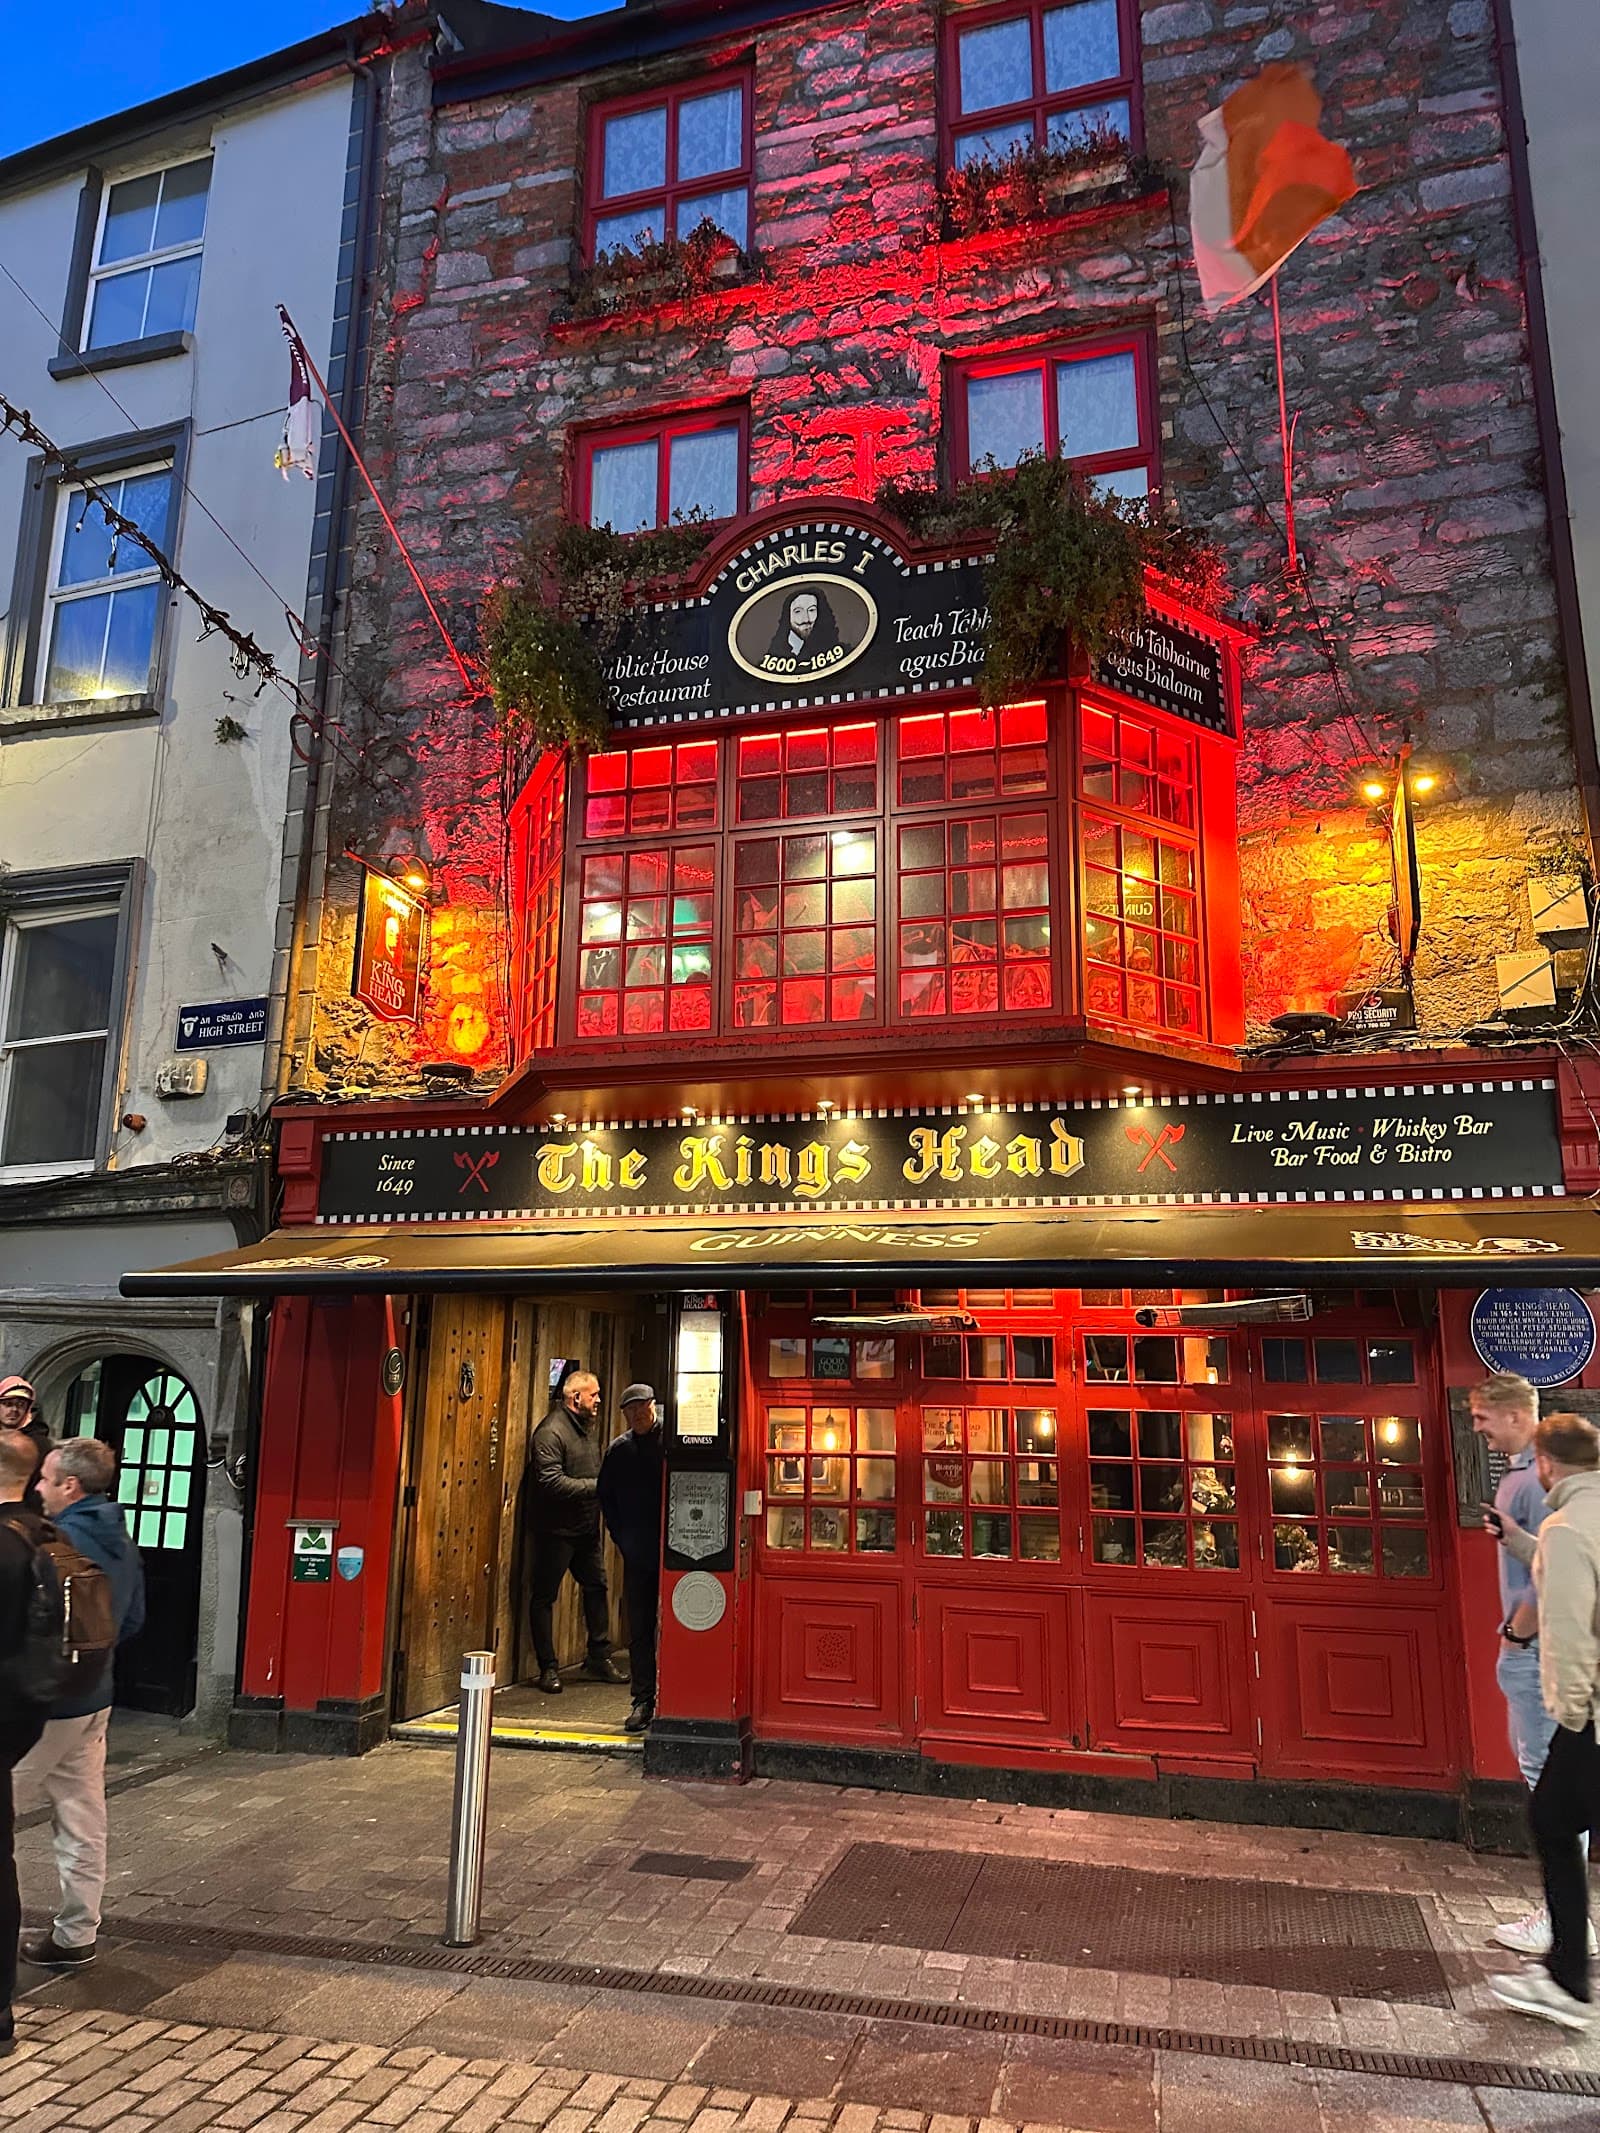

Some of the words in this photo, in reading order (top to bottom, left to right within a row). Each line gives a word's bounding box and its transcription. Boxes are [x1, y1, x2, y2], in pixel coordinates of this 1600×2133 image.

[736, 541, 847, 592] CHARLES
[853, 550, 874, 575] I
[893, 615, 943, 643] Teach
[1145, 628, 1211, 681] Tábhairne
[601, 655, 649, 680] ublic
[1144, 656, 1204, 705] Bialann
[608, 677, 712, 711] Restaurant
[369, 980, 402, 1010] HEAD
[1363, 1008, 1397, 1019] SECURITY
[198, 1025, 224, 1039] HIGH
[227, 1020, 265, 1035] STREET
[1231, 1123, 1274, 1144] Live
[1281, 1120, 1350, 1142] Music
[1372, 1116, 1448, 1144] Whiskey
[1453, 1114, 1494, 1136] Bar
[378, 1154, 416, 1171] Since
[534, 1136, 648, 1193] The
[673, 1133, 871, 1198] Kings
[902, 1117, 1085, 1184] Head
[1270, 1147, 1308, 1167] Bar
[1313, 1144, 1361, 1166] Food
[1369, 1143, 1388, 1164] &
[1396, 1142, 1452, 1164] Bistro
[376, 1176, 414, 1196] 1649
[690, 1228, 981, 1251] GUINNESS
[1494, 1302, 1510, 1310] THE
[1545, 1302, 1570, 1310] HEAD
[682, 1435, 713, 1445] GUINNESS
